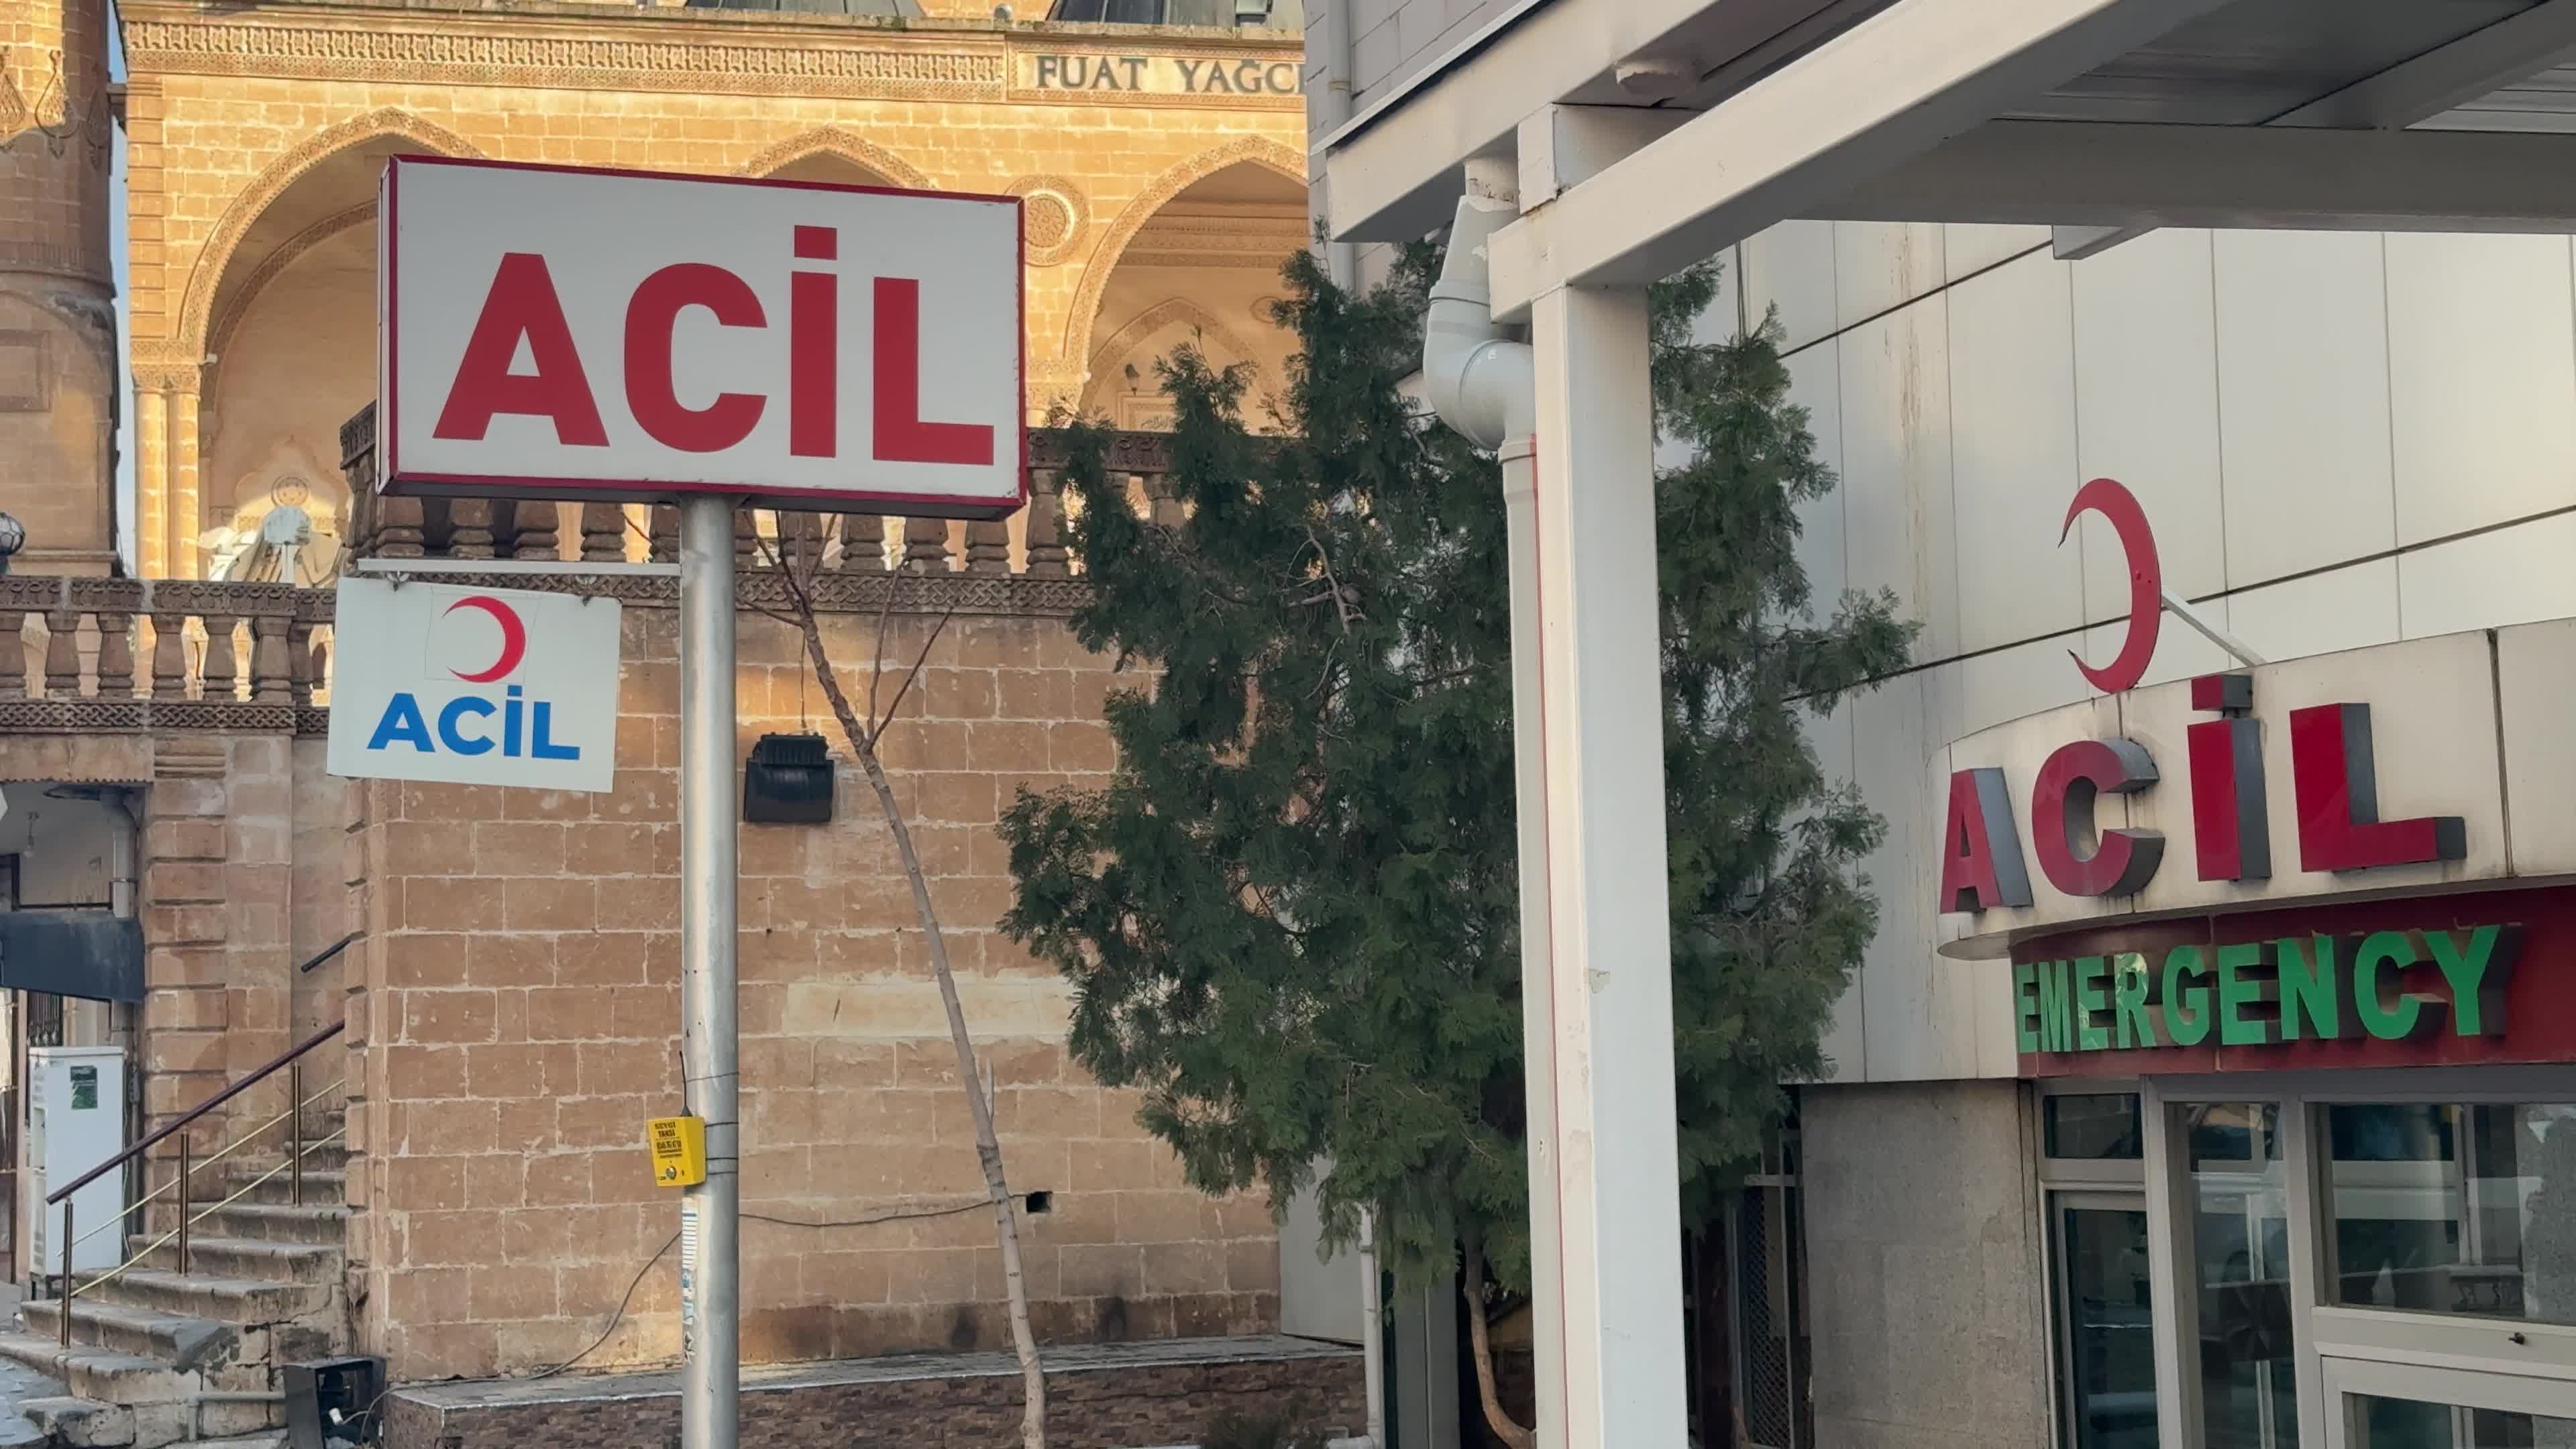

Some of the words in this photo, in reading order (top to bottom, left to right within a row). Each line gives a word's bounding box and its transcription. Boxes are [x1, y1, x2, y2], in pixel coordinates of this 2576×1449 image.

[1035, 54, 1148, 92] FUAT
[431, 225, 995, 466] ACİL
[366, 684, 581, 760] ACİL
[1939, 673, 2467, 914] ACİL
[2015, 924, 2512, 1054] EMERGENCY
